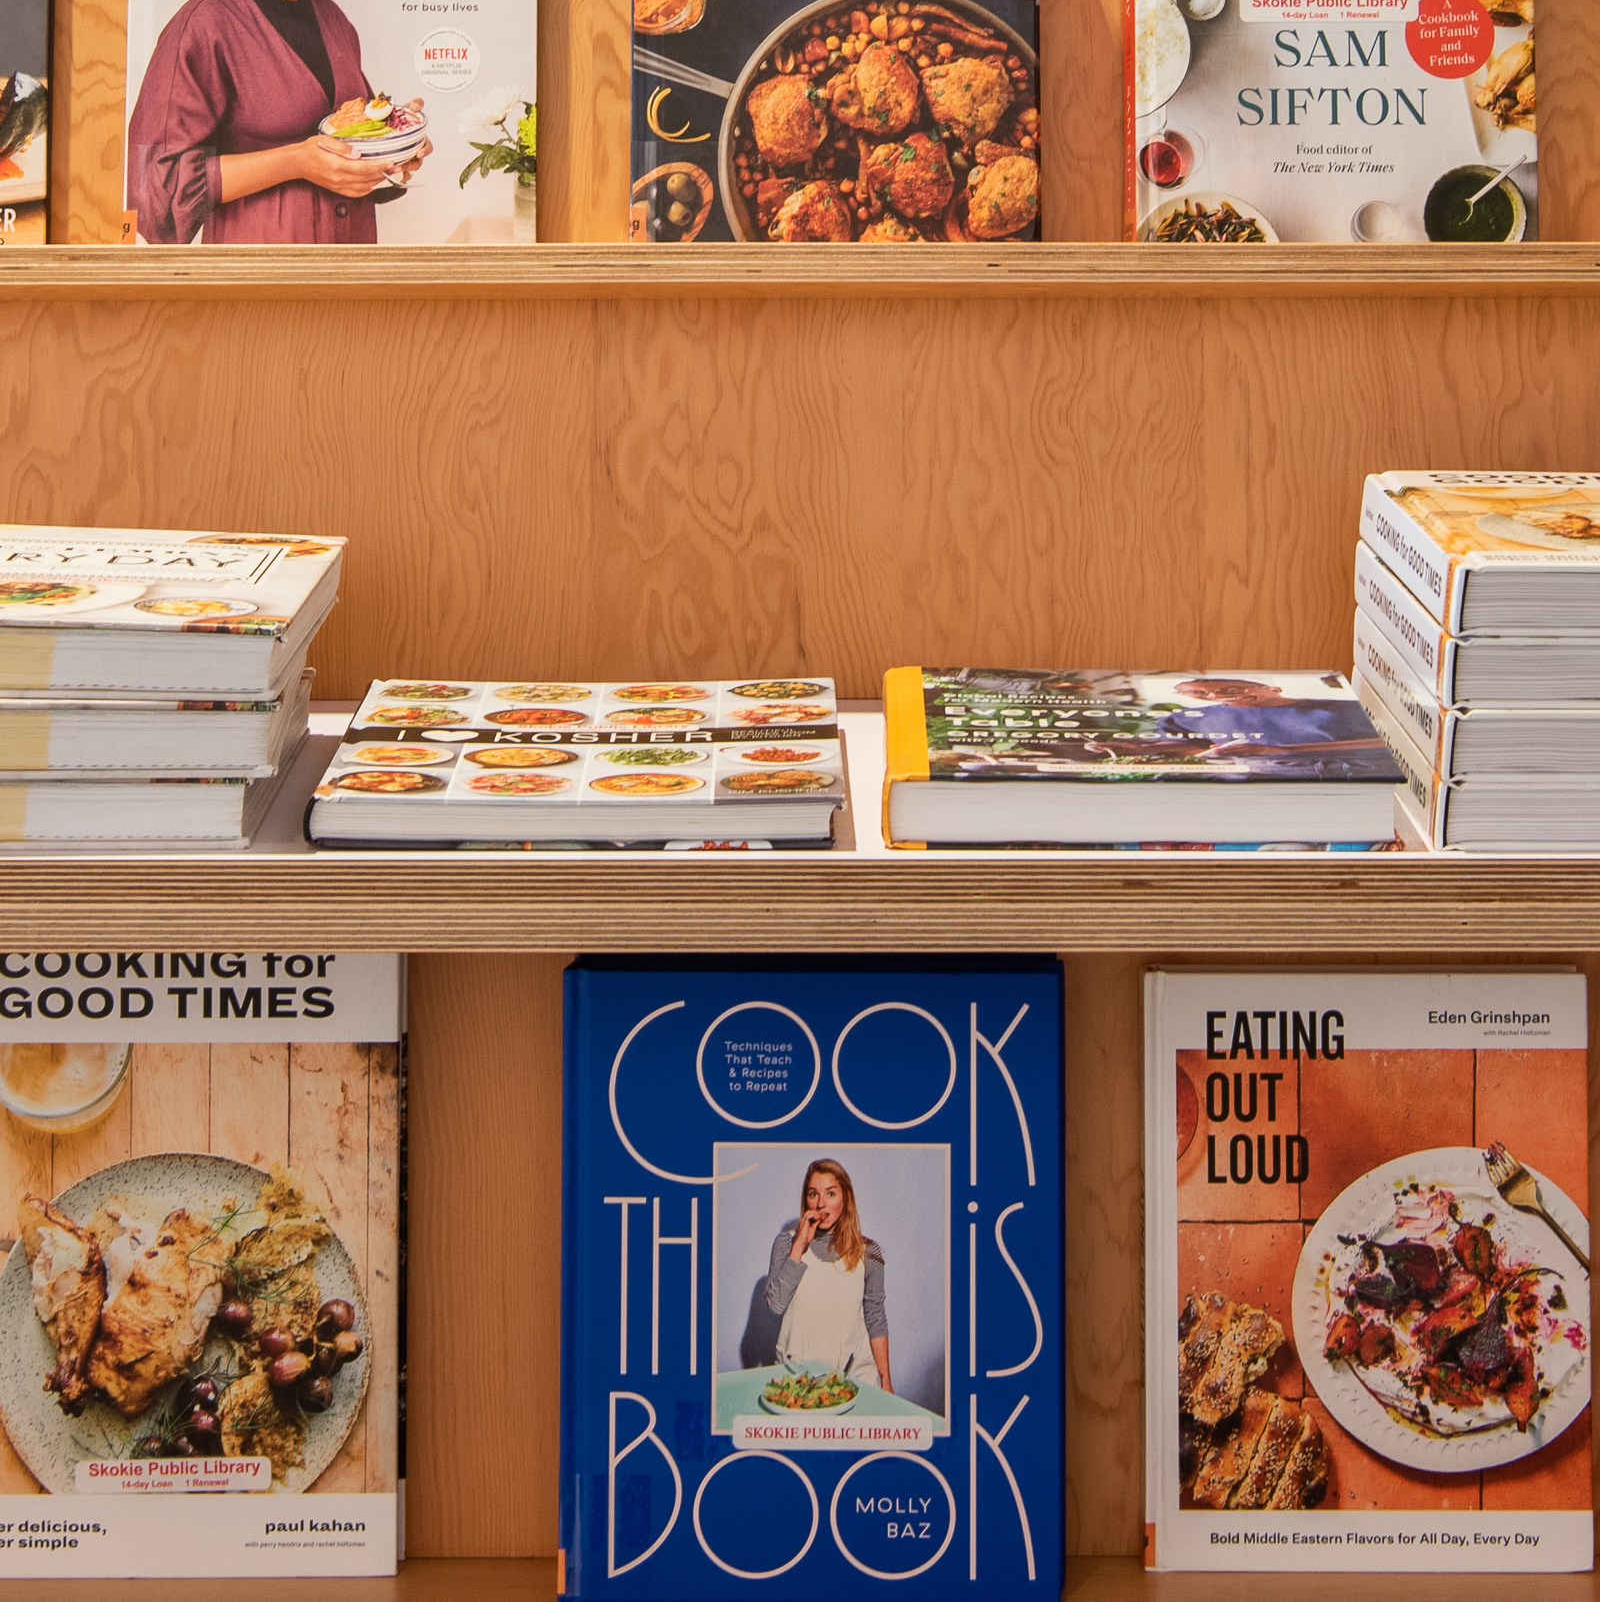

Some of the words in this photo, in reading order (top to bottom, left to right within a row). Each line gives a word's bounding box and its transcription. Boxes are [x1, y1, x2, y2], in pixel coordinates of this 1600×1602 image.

[424, 48, 468, 60] NETFLIX
[1273, 29, 1389, 68] SAM
[1236, 87, 1427, 127] SIFTON
[1295, 143, 1322, 155] Food
[1325, 143, 1358, 155] editor
[1360, 143, 1374, 155] of
[1272, 161, 1295, 173] The
[1297, 161, 1324, 173] New
[1326, 161, 1354, 173] York
[1357, 161, 1395, 173] Times
[107, 555, 243, 568] DAY
[1376, 513, 1400, 553] COOKING
[1400, 535, 1409, 561] for
[1408, 546, 1425, 579] GOOD
[1425, 562, 1442, 598] TIMES
[397, 730, 406, 740] I
[493, 731, 713, 743] KOSHER
[167, 986, 335, 1020] TIMES
[1428, 1011, 1467, 1025] Eden
[1470, 1010, 1551, 1027] Grinshpan
[1206, 1010, 1345, 1060] EATING
[608, 1000, 1037, 1187] COOK
[1206, 1072, 1284, 1123] OUT
[1207, 1134, 1309, 1184] LOUD
[745, 1426, 800, 1441] SKOKIE
[803, 1426, 856, 1441] PUBLIC
[859, 1426, 922, 1441] LIBRARY
[607, 1391, 1036, 1581] BOOK
[855, 1498, 932, 1514] MOLLY
[17, 1518, 108, 1536] delicious,
[265, 1520, 304, 1534] paul
[309, 1520, 366, 1532] kahan
[887, 1522, 932, 1539] BAZ
[17, 1535, 79, 1551] simple
[1210, 1532, 1240, 1545] Bold
[1243, 1532, 1289, 1545] Middle
[1292, 1532, 1343, 1545] Eastern
[1346, 1532, 1394, 1545] Flavors
[1398, 1532, 1417, 1545] for
[1419, 1532, 1438, 1545] All
[1441, 1532, 1470, 1545] Day,
[1474, 1532, 1511, 1545] Every
[1514, 1532, 1540, 1545] Day
